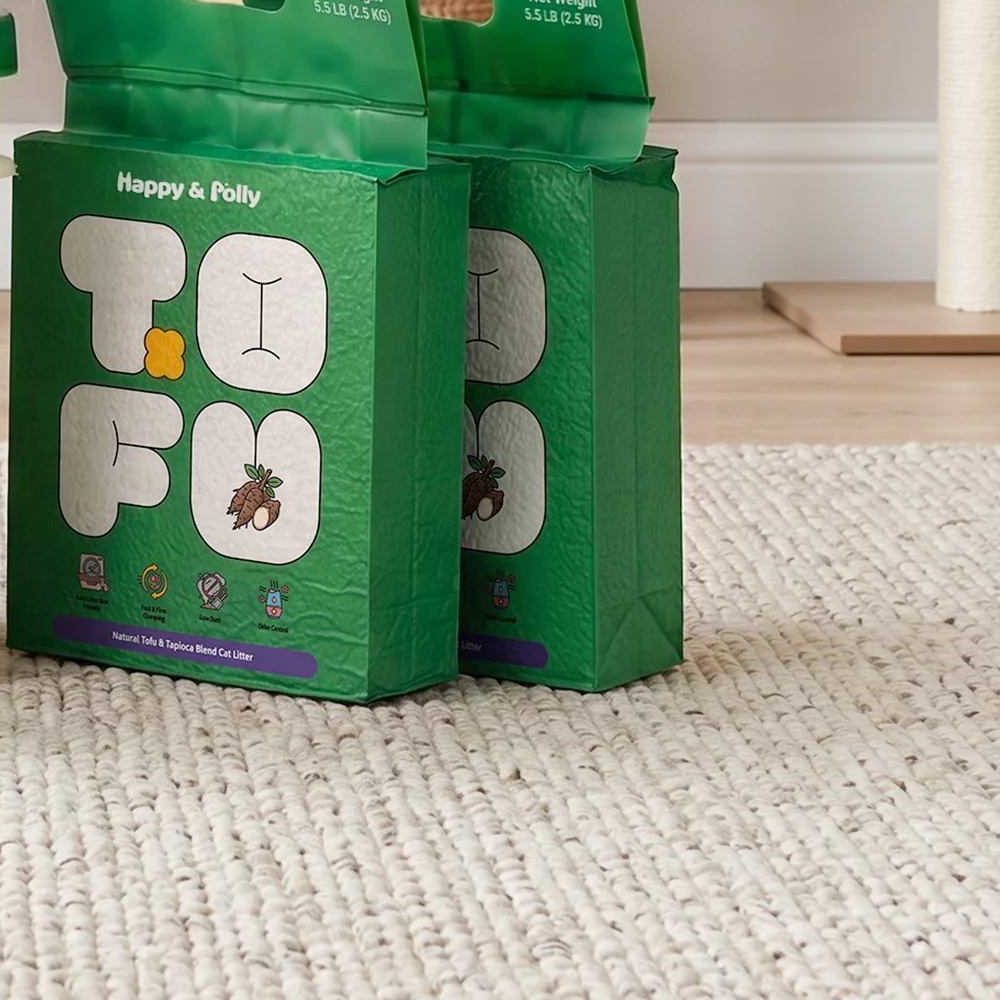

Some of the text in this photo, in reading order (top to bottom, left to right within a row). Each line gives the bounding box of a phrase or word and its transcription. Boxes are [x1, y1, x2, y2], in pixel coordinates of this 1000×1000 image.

[314, 0, 391, 26] 5.5 LB (2.5 KG)
[524, 7, 603, 30] 5.5 LB (2.5 KG)
[117, 171, 261, 208] Happy & Polly
[112, 631, 253, 662] Natural Tofu & Tapioca Blend Cat Litter
[461, 640, 482, 652] Litter
